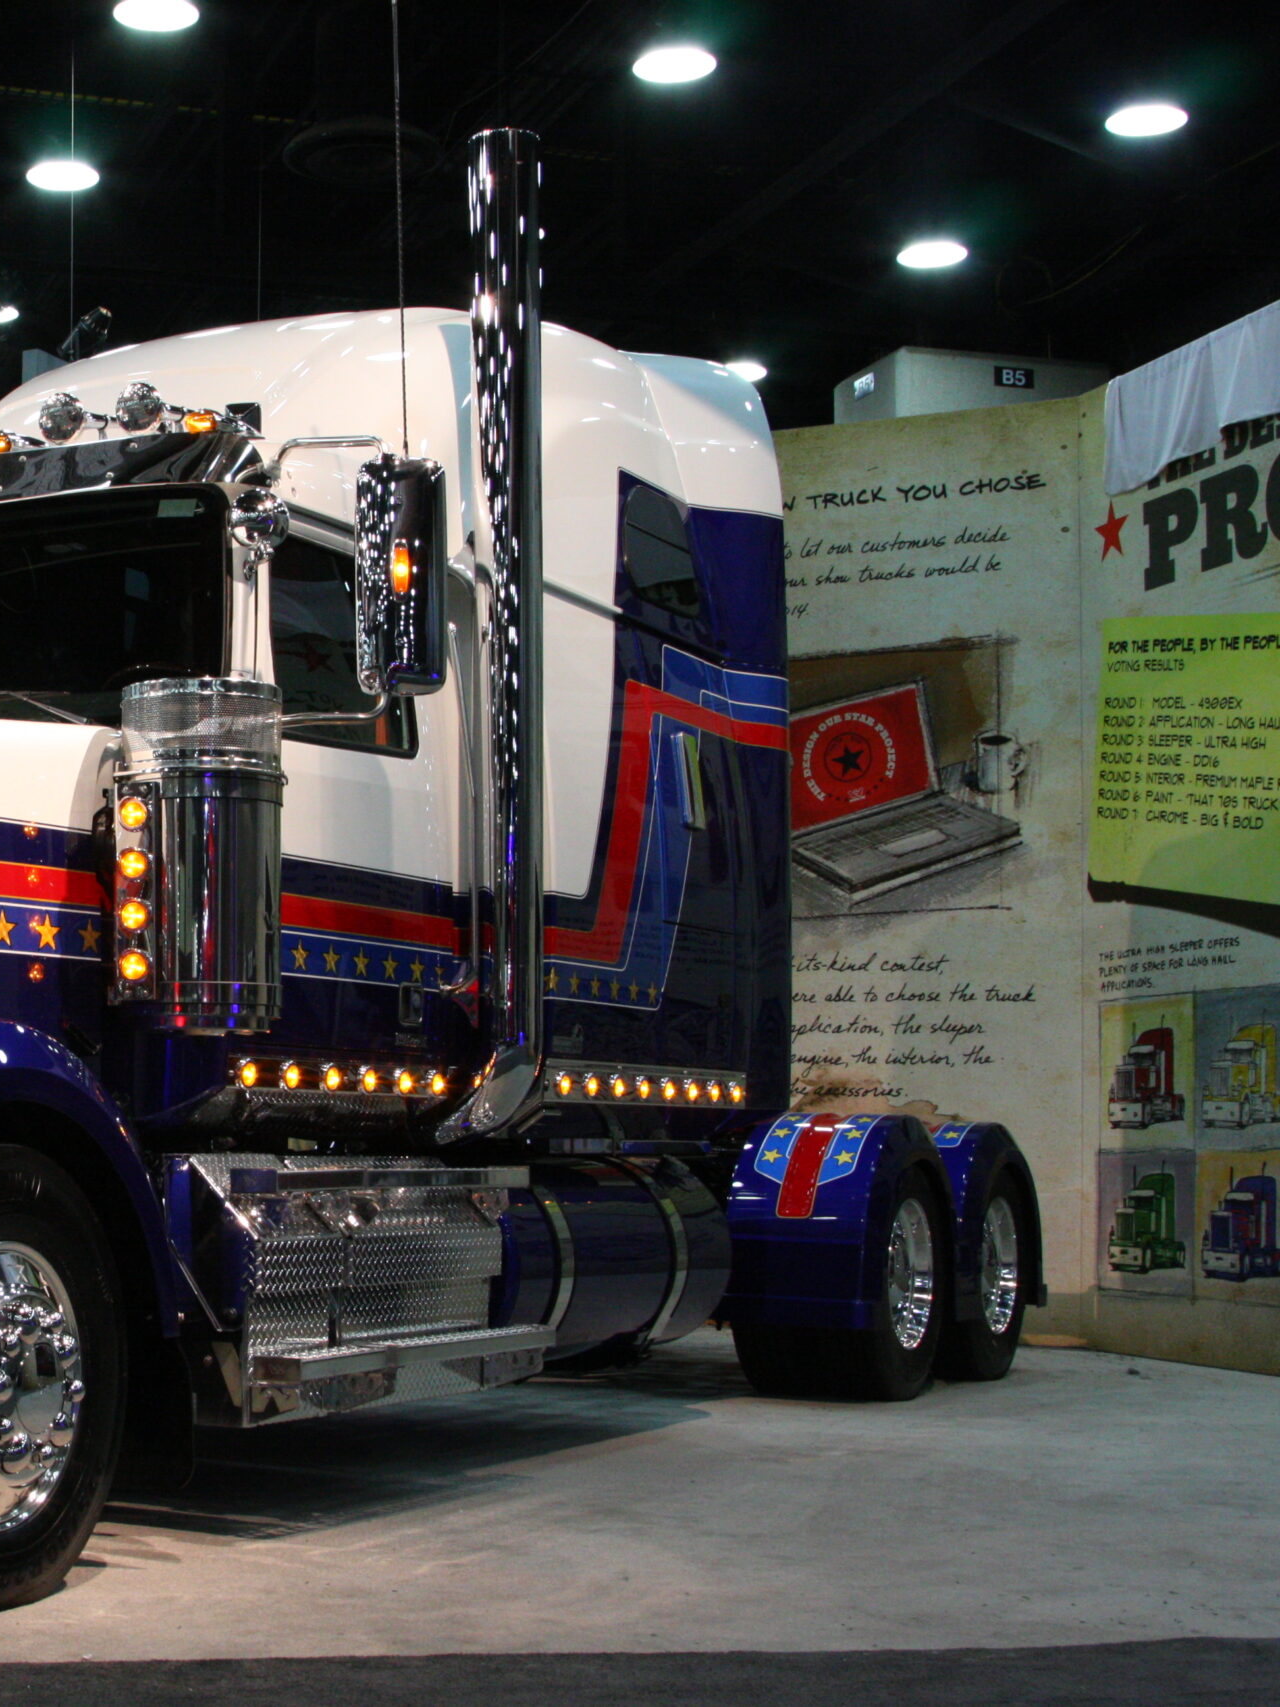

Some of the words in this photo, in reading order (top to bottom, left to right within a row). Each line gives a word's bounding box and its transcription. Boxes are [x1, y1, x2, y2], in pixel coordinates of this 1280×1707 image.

[1001, 368, 1026, 386] B5
[806, 486, 887, 509] TRUCK
[896, 483, 948, 503] YOU
[959, 473, 1047, 496] CHOSE
[1143, 452, 1280, 592] PR
[801, 537, 823, 559] let
[827, 542, 854, 554] our
[860, 531, 946, 553] customers
[954, 525, 1012, 544] decide
[858, 562, 916, 583] trucks
[924, 554, 981, 578] would
[984, 553, 1002, 571] be
[1108, 640, 1128, 654] FOR
[1131, 639, 1150, 653] THE
[1152, 638, 1196, 654] PEOPLE,
[1200, 638, 1216, 651] BY
[1220, 636, 1240, 650] THE
[1108, 659, 1140, 673] VOTING
[1143, 659, 1185, 672] RESULTS
[1105, 697, 1137, 710] ROUND
[1152, 697, 1186, 709] MODEL
[818, 714, 842, 732] OUR
[844, 712, 876, 727] STAR
[1103, 715, 1136, 728] ROUND
[1149, 715, 1215, 729] APPLICATION
[1226, 716, 1255, 729] LONG
[874, 722, 896, 779] PROJECT
[1102, 733, 1134, 746] ROUND
[1148, 734, 1193, 747] SLEEPER
[1204, 735, 1237, 749] ULTRA
[1241, 736, 1267, 750] HIGH
[802, 731, 820, 778] DESIGN
[1100, 752, 1133, 765] ROUND
[1147, 753, 1182, 766] ENGINE
[806, 778, 826, 802] THE
[1099, 770, 1131, 783] ROUND
[1146, 772, 1185, 786] INTERIOR
[1195, 773, 1237, 788] PREMIUM
[1240, 776, 1274, 791] MAPLE
[1098, 788, 1130, 801] ROUND
[1145, 790, 1175, 804] PAINT
[1097, 806, 1129, 820] ROUND
[1145, 810, 1189, 825] CHROME
[1200, 813, 1219, 827] BIG
[1233, 816, 1264, 830] BOLD
[791, 952, 876, 973] -its-kind
[880, 953, 951, 975] contest,
[791, 991, 817, 1003] ere
[824, 984, 856, 1003] able
[864, 987, 878, 1002] to
[885, 982, 943, 1002] choose
[950, 982, 978, 1003] the
[985, 984, 1037, 1003] truck
[892, 1013, 921, 1035] the
[930, 1014, 986, 1045] sleeper
[852, 1046, 878, 1065] the
[885, 1048, 956, 1068] interior,
[963, 1045, 995, 1065] the
[790, 1076, 808, 1096] he
[813, 1082, 909, 1098] accessories.
